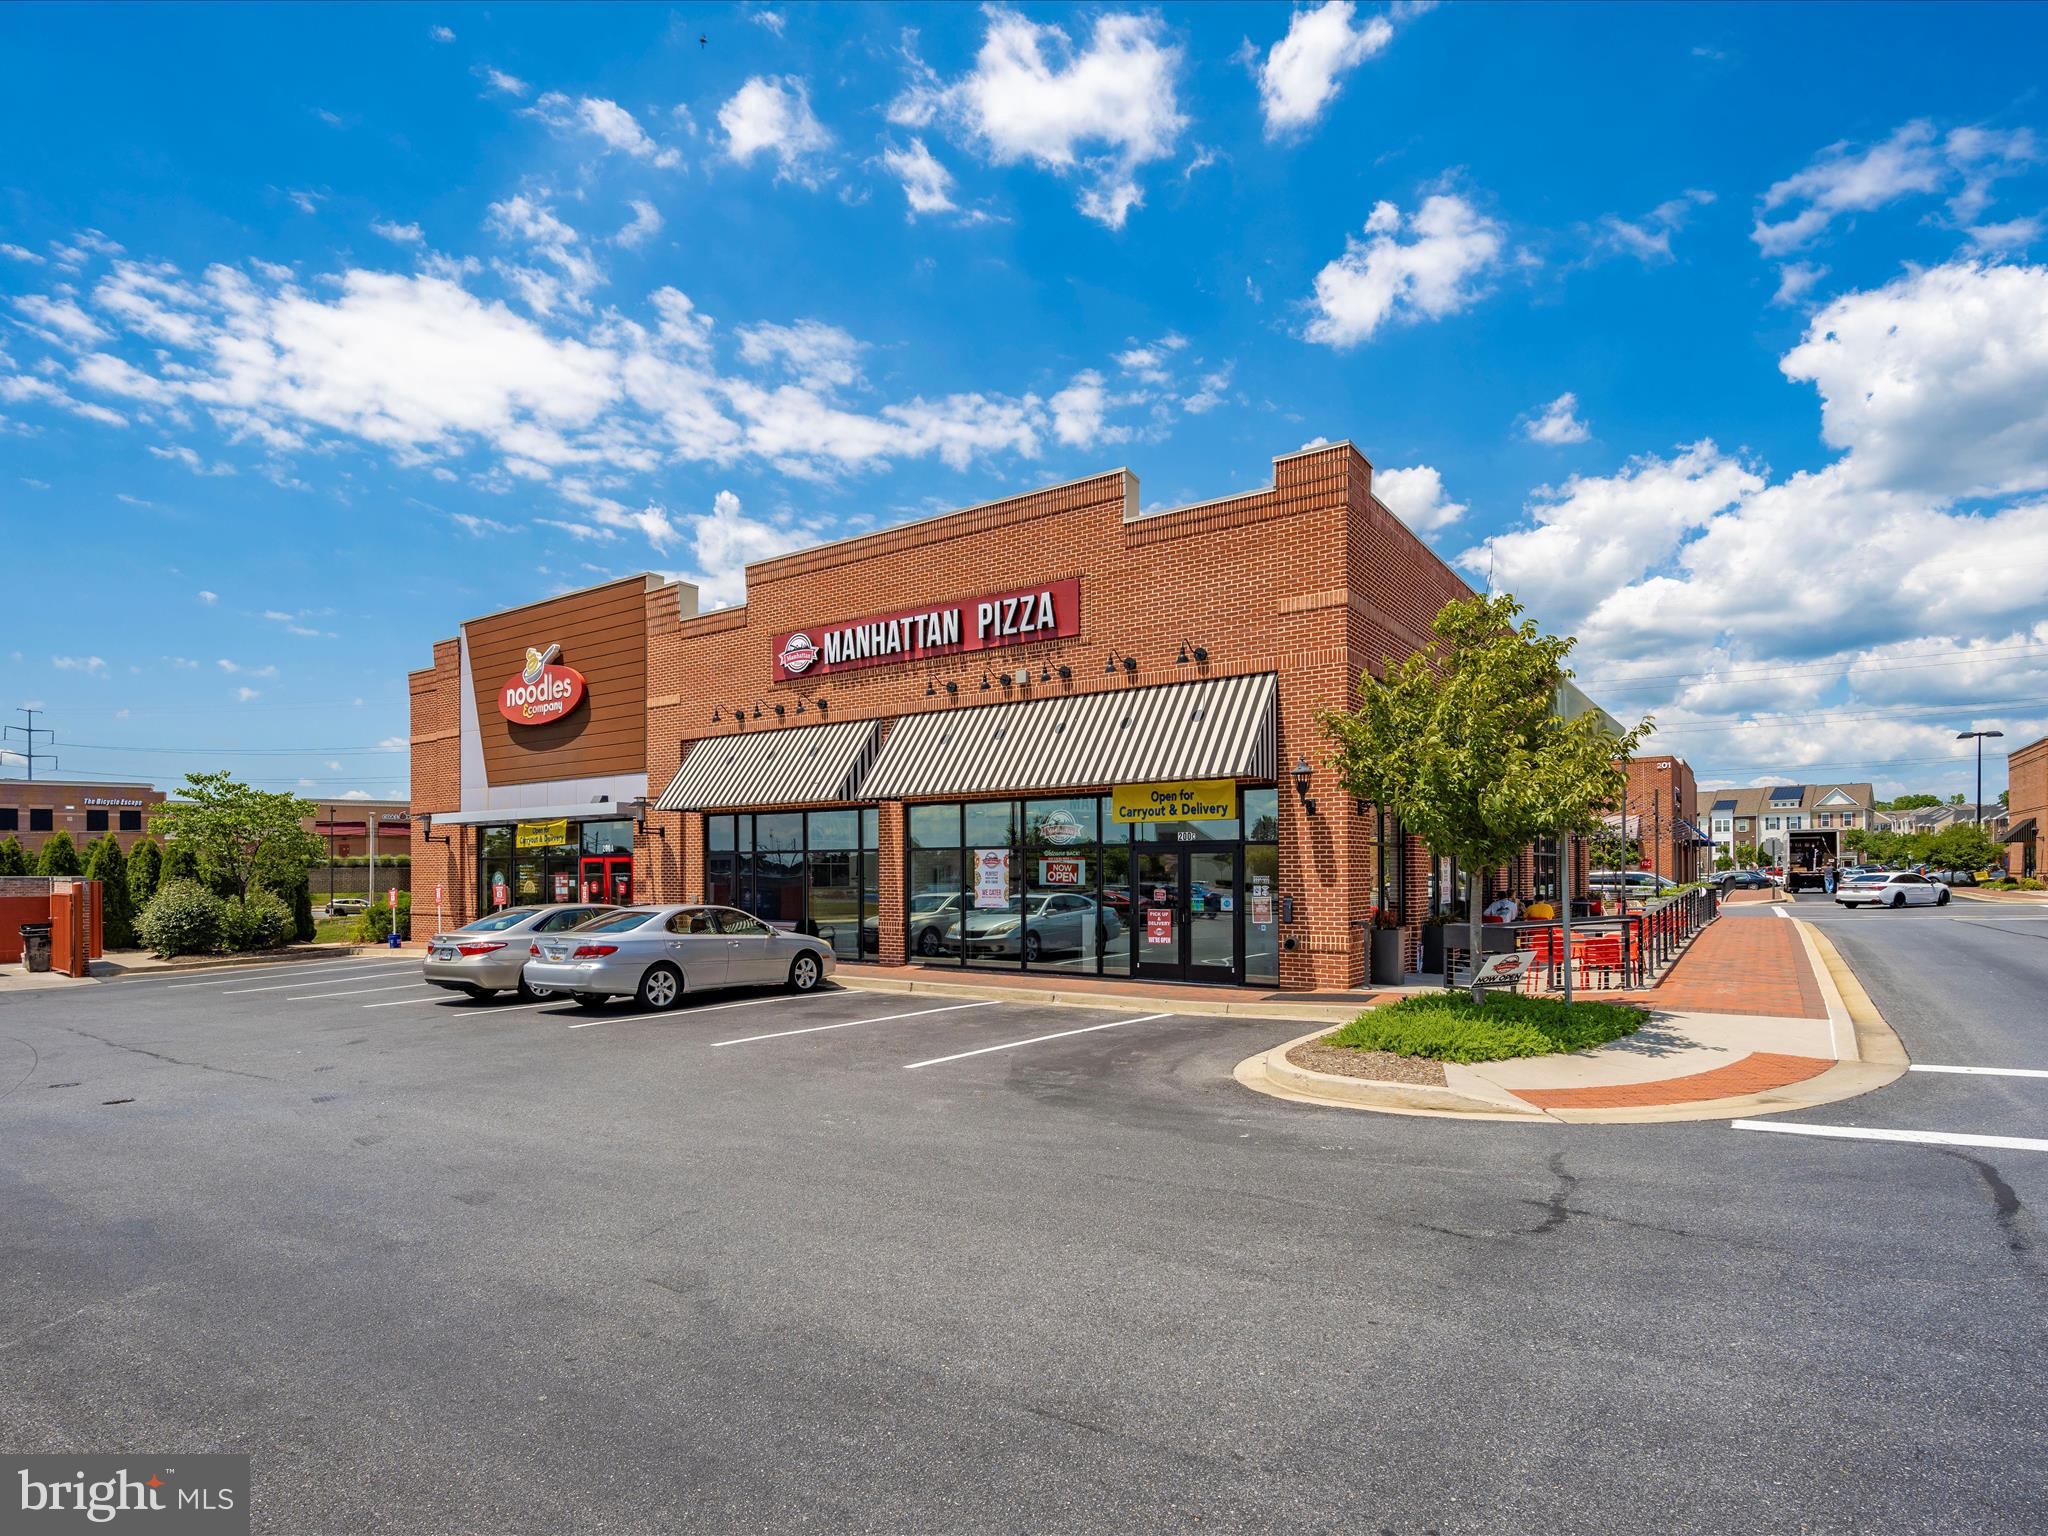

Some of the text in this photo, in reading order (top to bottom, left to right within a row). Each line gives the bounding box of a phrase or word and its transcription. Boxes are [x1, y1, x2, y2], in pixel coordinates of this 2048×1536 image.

[824, 591, 1055, 664] MANHATTAN PIZZA
[506, 671, 572, 707] noodles
[96, 798, 119, 806] Bicycle
[120, 799, 143, 807] Escape
[1151, 788, 1195, 805] Open for
[1119, 802, 1229, 820] Carryout & Delivery
[1053, 864, 1073, 872] NOW
[1047, 871, 1078, 882] OPEN
[1476, 975, 1499, 984] NOW
[1498, 973, 1522, 981] OPEN
